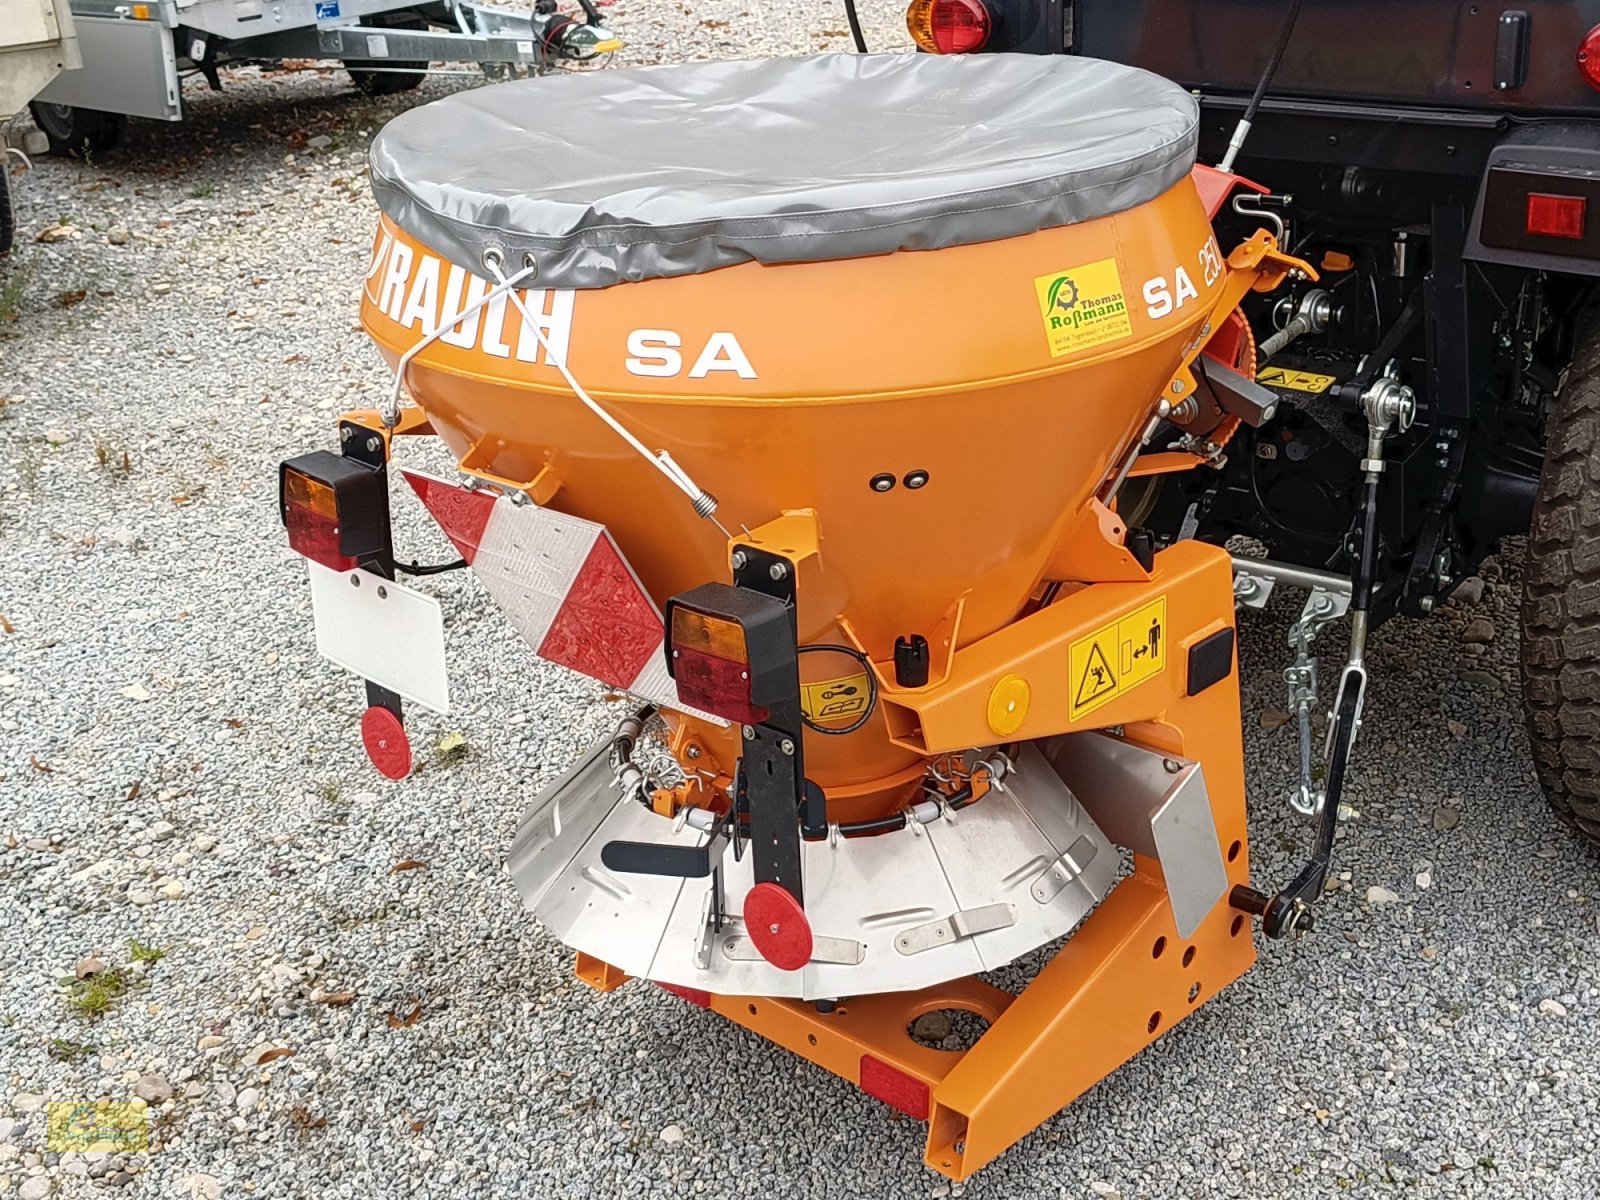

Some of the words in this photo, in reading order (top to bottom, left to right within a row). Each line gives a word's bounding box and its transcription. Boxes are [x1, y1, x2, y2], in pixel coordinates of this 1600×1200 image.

[1142, 265, 1199, 320] SA
[1198, 235, 1222, 288] 250
[1049, 301, 1125, 330] Roßmann
[1080, 292, 1123, 310] Thomas
[624, 328, 758, 379] SA
